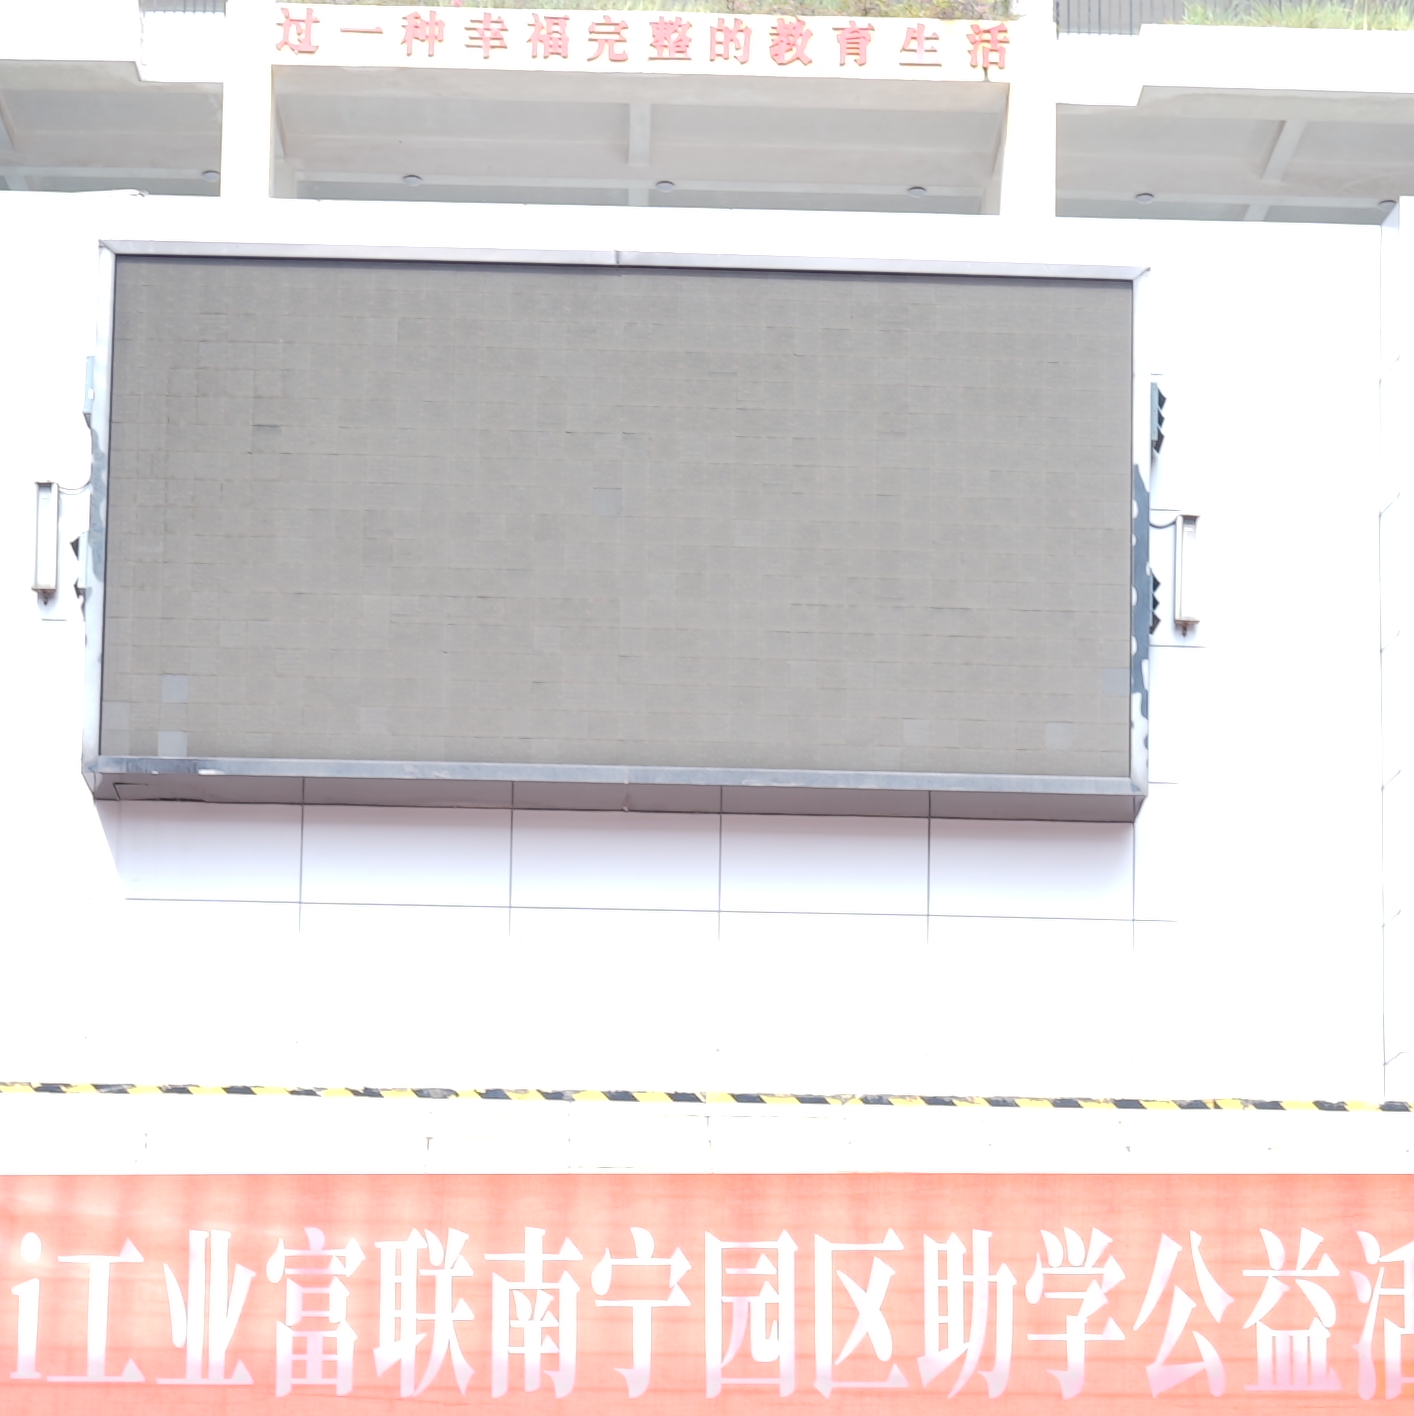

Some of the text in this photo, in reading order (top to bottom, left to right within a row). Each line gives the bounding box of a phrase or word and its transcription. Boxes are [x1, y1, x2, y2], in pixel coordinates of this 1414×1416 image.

[275, 8, 1012, 70] 过一种幸福完整的教育生活
